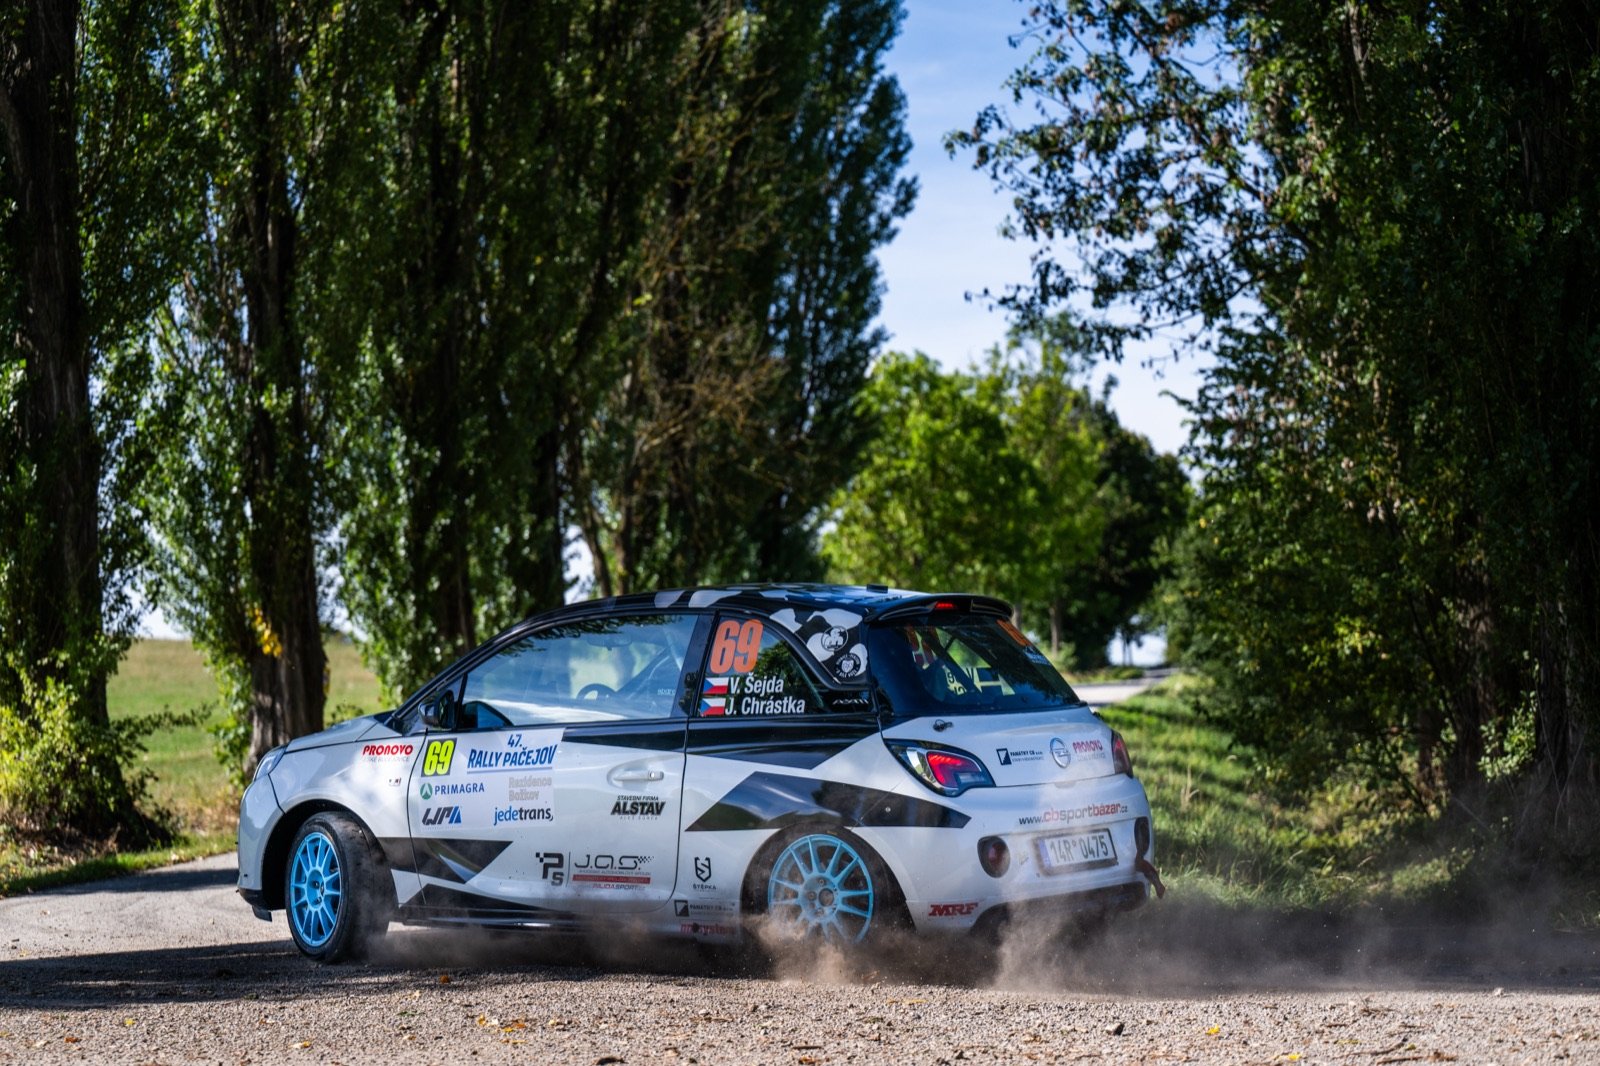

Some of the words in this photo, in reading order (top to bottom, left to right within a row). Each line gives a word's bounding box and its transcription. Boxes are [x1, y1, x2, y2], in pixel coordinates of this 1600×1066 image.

[710, 619, 763, 674] 69
[730, 677, 740, 693] V.
[744, 672, 784, 696] Šejda
[725, 698, 737, 715] J.
[741, 695, 805, 714] Chrástka
[363, 744, 413, 756] PRONOVO
[423, 740, 454, 776] 69
[467, 749, 502, 768] RALLY
[502, 744, 558, 767] PAČEJOV
[435, 783, 485, 795] PRIMAGRA
[610, 801, 666, 815] ALSTAV
[1078, 834, 1109, 859] 0475
[928, 902, 979, 916] MRF
